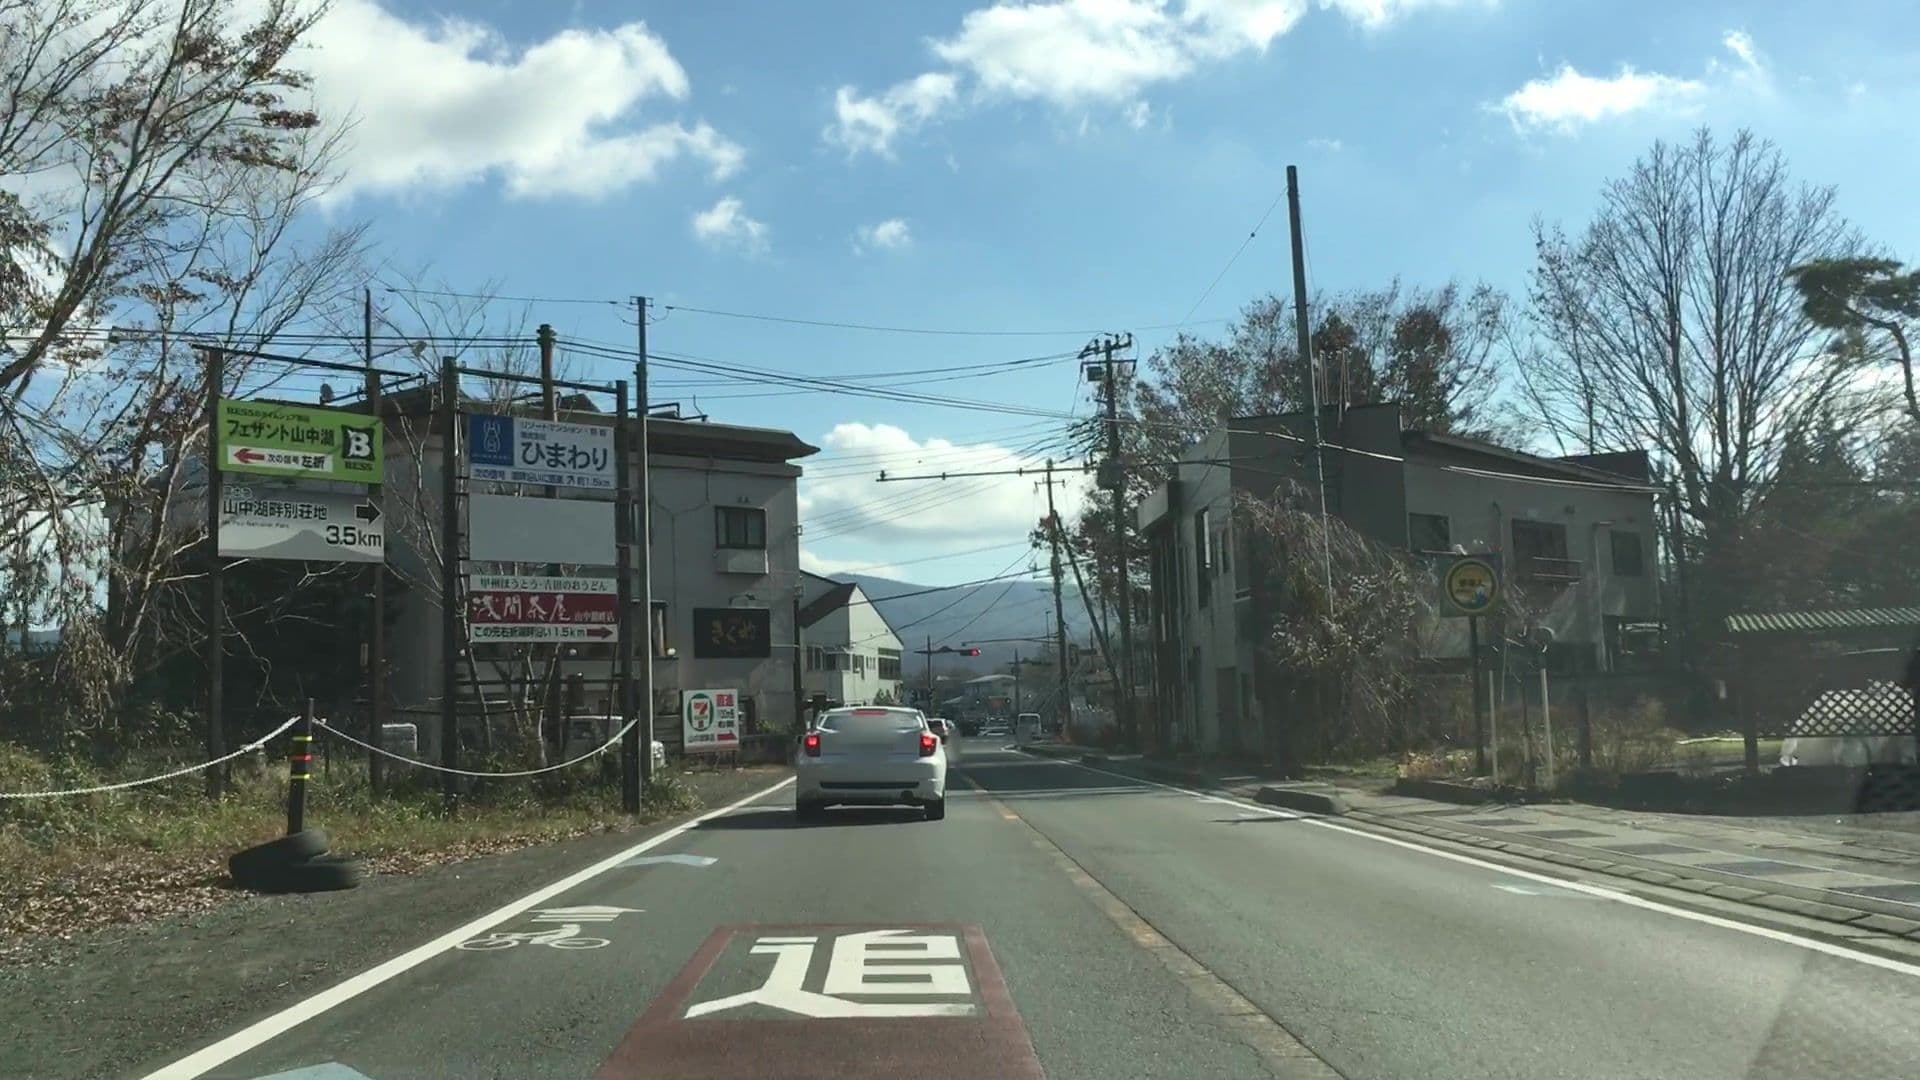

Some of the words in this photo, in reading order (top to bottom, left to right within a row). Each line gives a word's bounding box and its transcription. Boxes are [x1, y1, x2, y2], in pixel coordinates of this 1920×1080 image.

[227, 420, 334, 446] フェザント山中湖
[520, 440, 608, 472] ひまわり
[222, 498, 328, 521] 山中湖畔別荘地
[325, 525, 382, 548] 3.5km
[471, 593, 572, 623] 浅間茶屋
[683, 928, 976, 1019] 追
